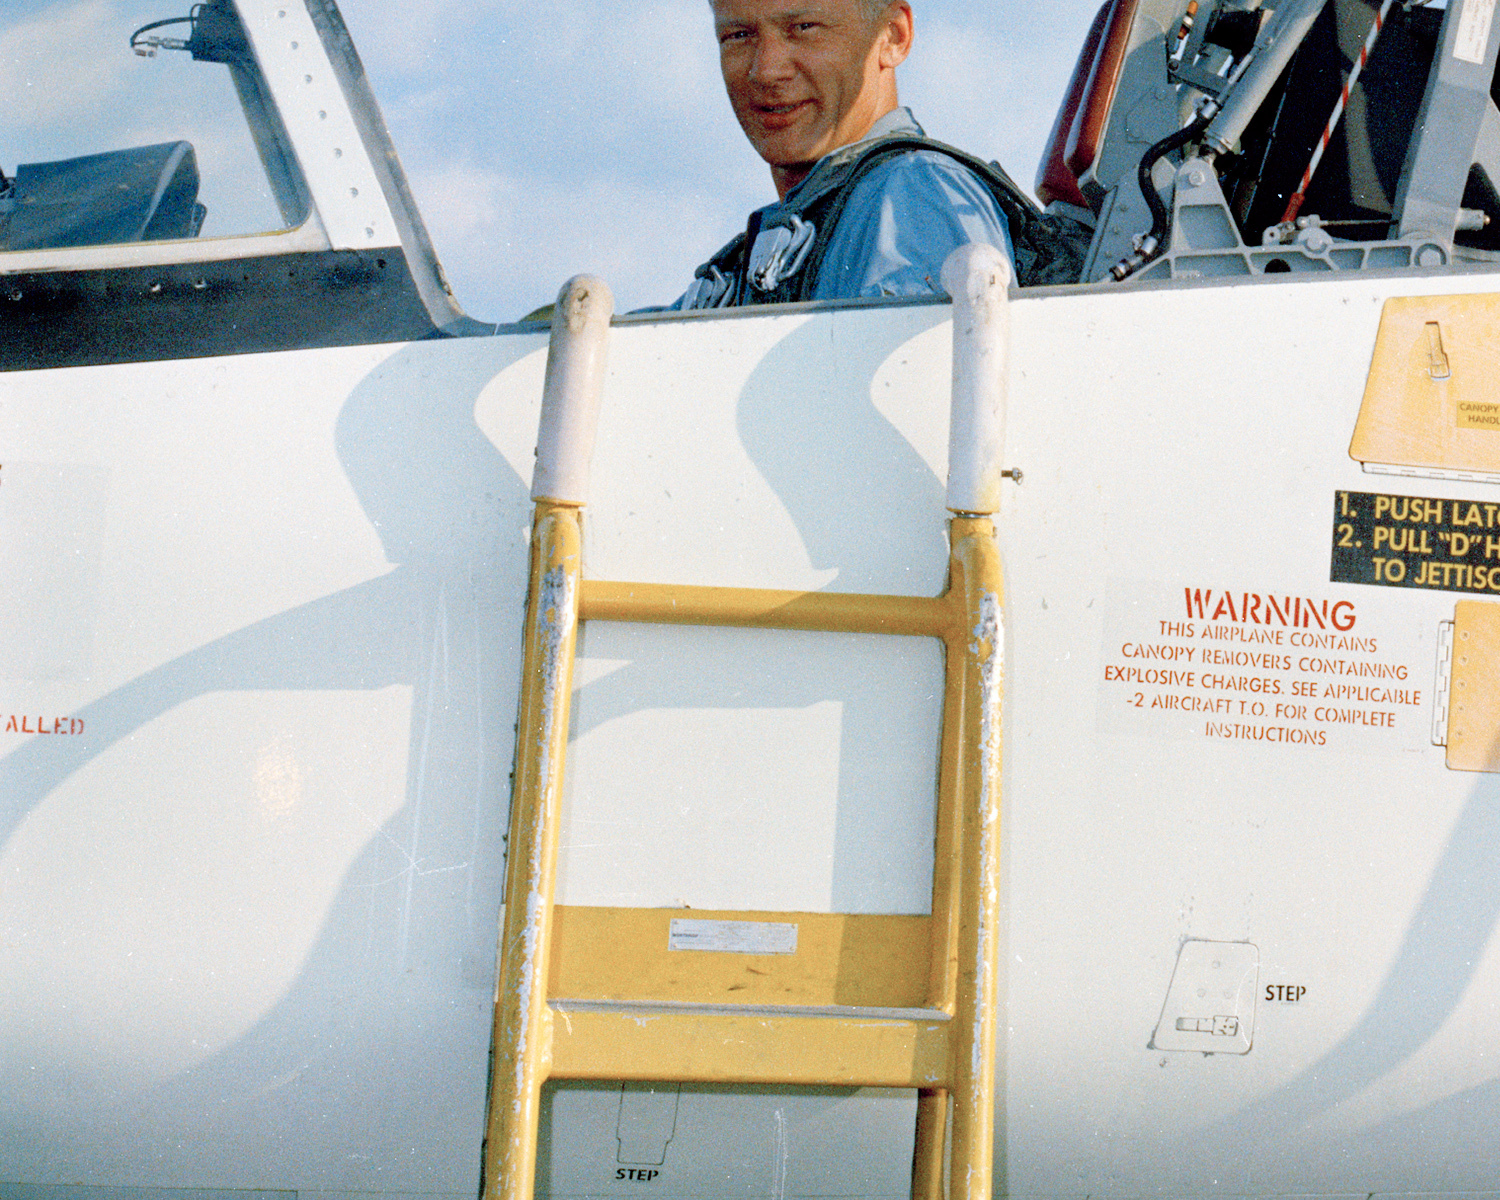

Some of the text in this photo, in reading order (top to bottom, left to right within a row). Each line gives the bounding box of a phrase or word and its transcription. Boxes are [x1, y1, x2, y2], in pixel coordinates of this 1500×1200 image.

[1460, 403, 1499, 414] CANOPY
[1339, 492, 1357, 518] 1.
[1375, 496, 1442, 524] PUSH
[1337, 523, 1362, 548] 2.
[1374, 527, 1432, 555] PULL
[1373, 556, 1405, 582] TO
[1185, 587, 1356, 632] WARNING
[1160, 620, 1377, 653] THIS AIRPLANE CONTAINS
[1122, 643, 1408, 680] CANOPY REMOVERS CONTAINING
[1105, 666, 1421, 706] EXPLOSIVE CHARGES. SEE APPLICABLE
[0, 714, 85, 736] ALLED
[1127, 692, 1395, 728] -2 AIRCRAFT T.O. FOR COMPLETE
[1205, 722, 1326, 745] INSTRUCTIONS
[1265, 985, 1307, 1002] STEP
[615, 1168, 659, 1181] STEP
